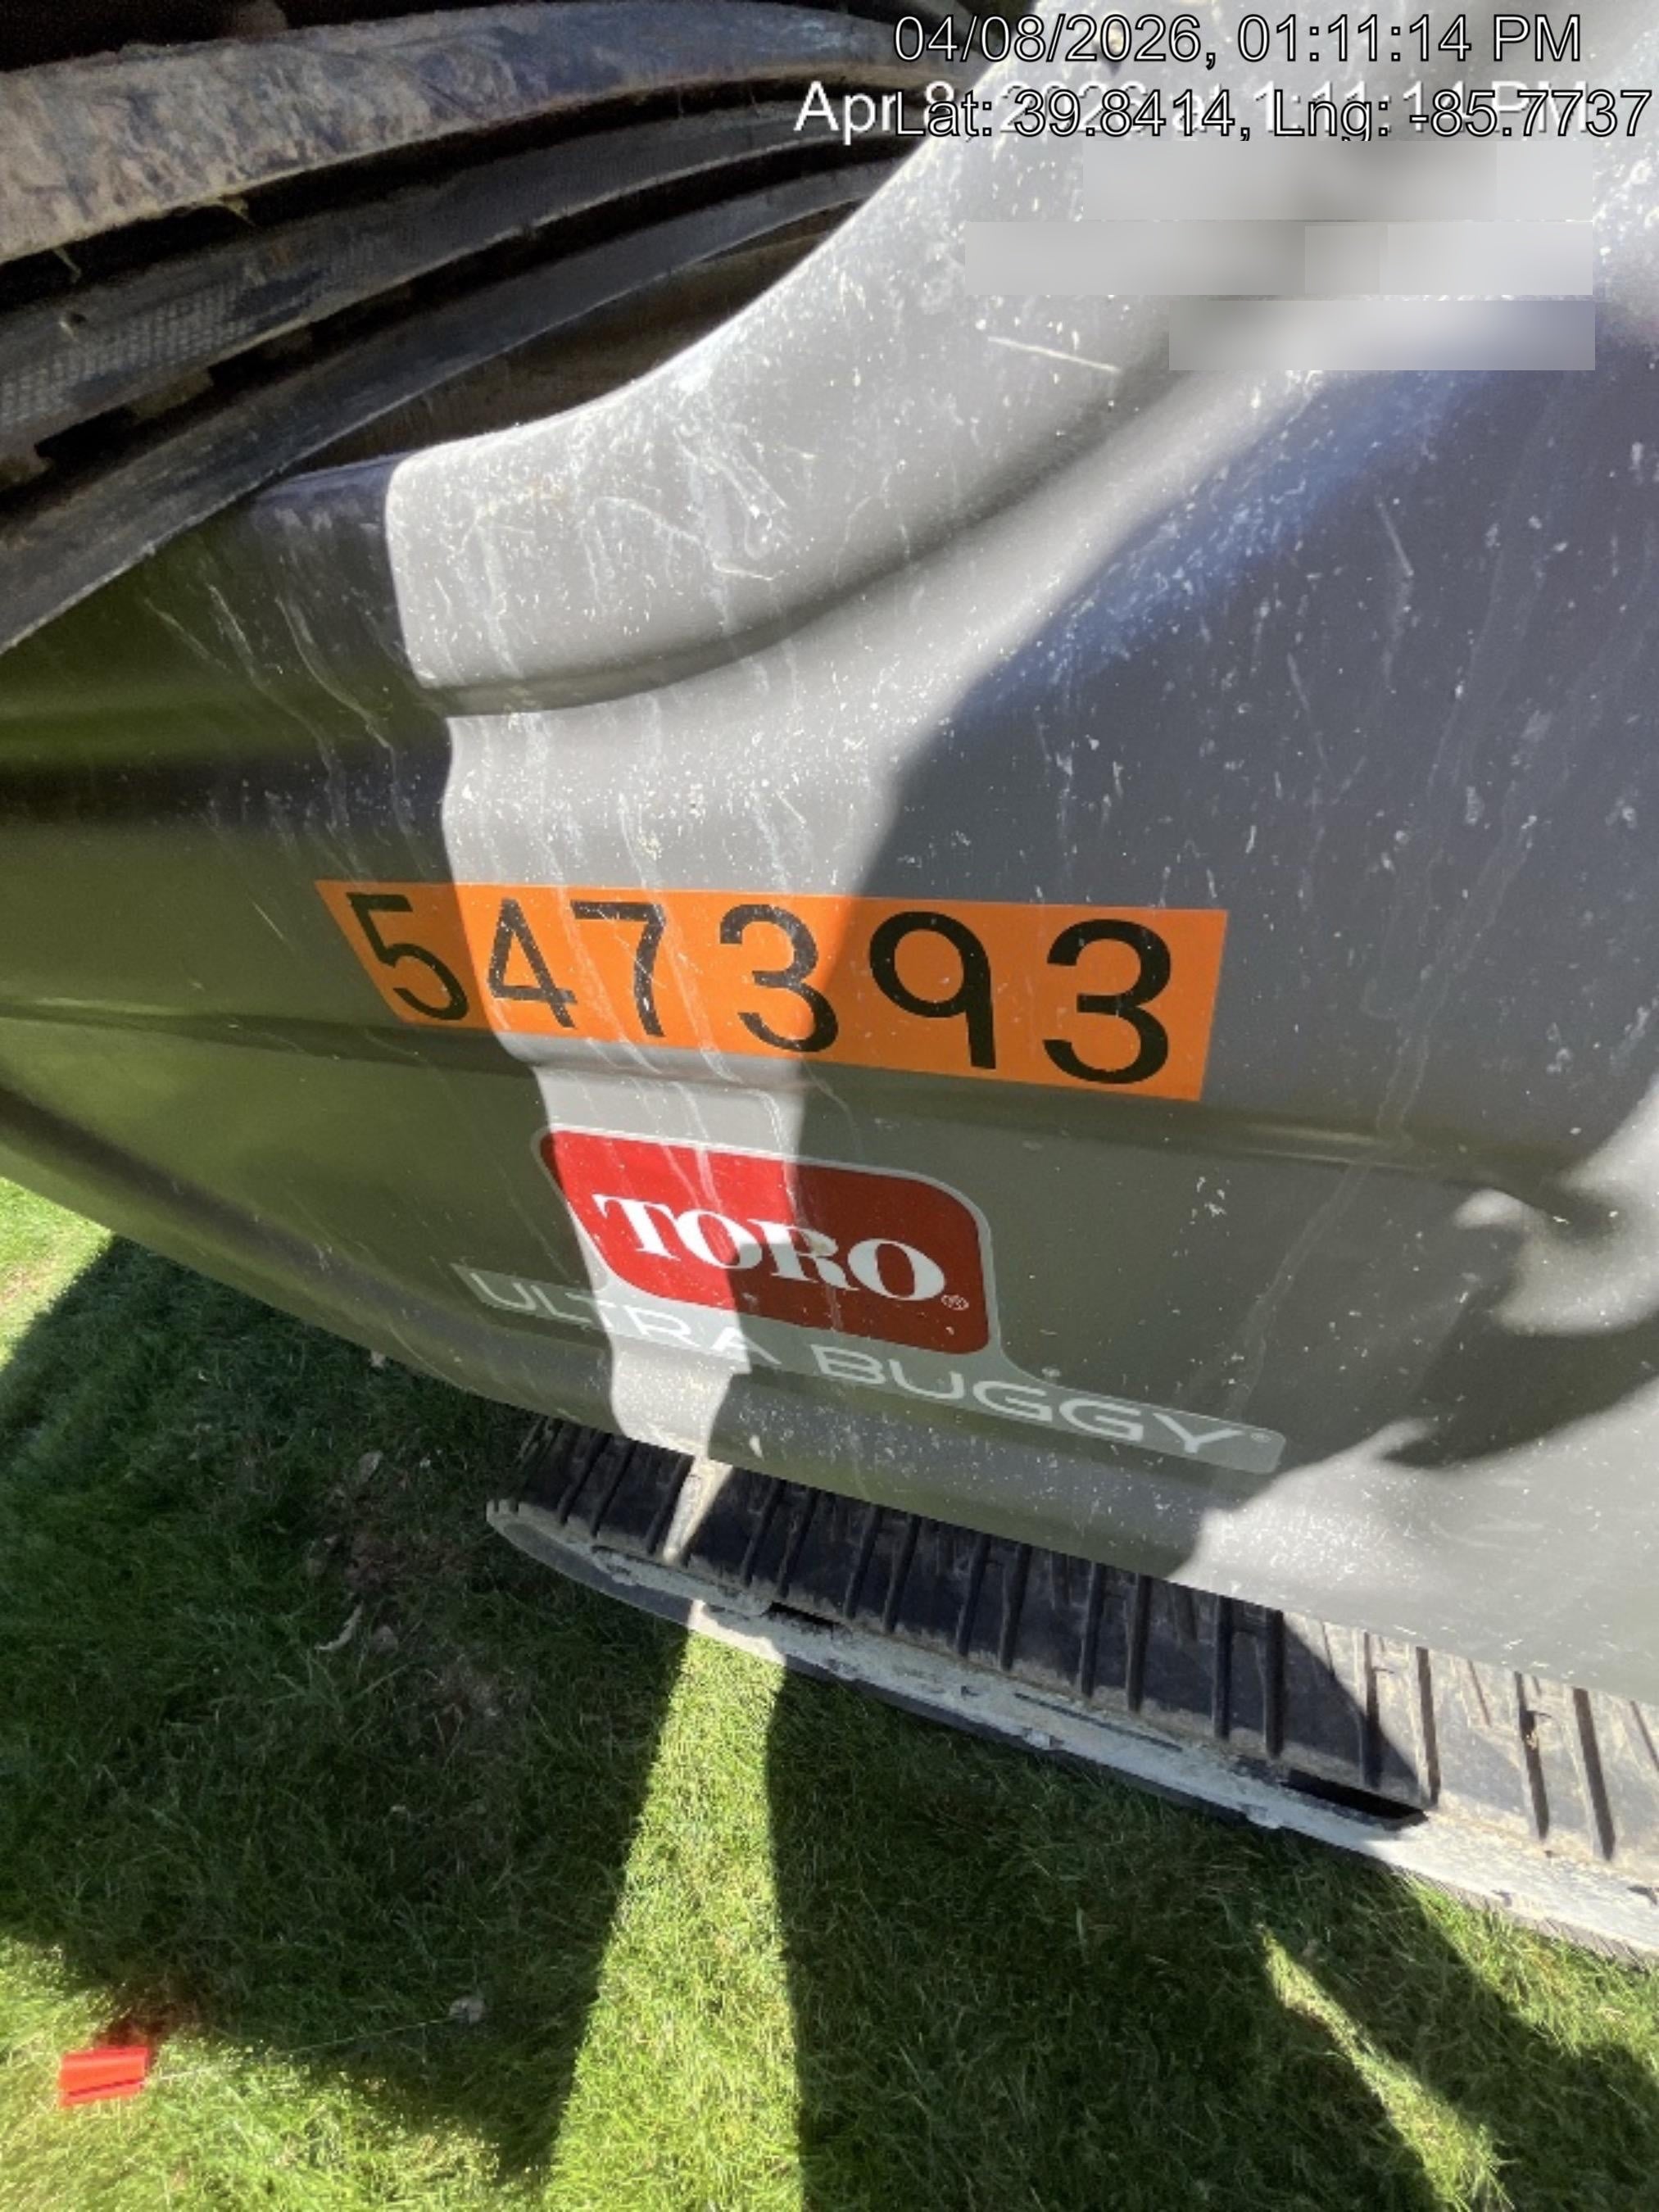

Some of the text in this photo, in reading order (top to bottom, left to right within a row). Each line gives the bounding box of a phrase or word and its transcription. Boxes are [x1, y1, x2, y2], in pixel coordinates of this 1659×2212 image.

[346, 892, 1173, 1084] 547393
[593, 1194, 945, 1301] TORO
[470, 1271, 1242, 1453] ULTRA BUGGY
